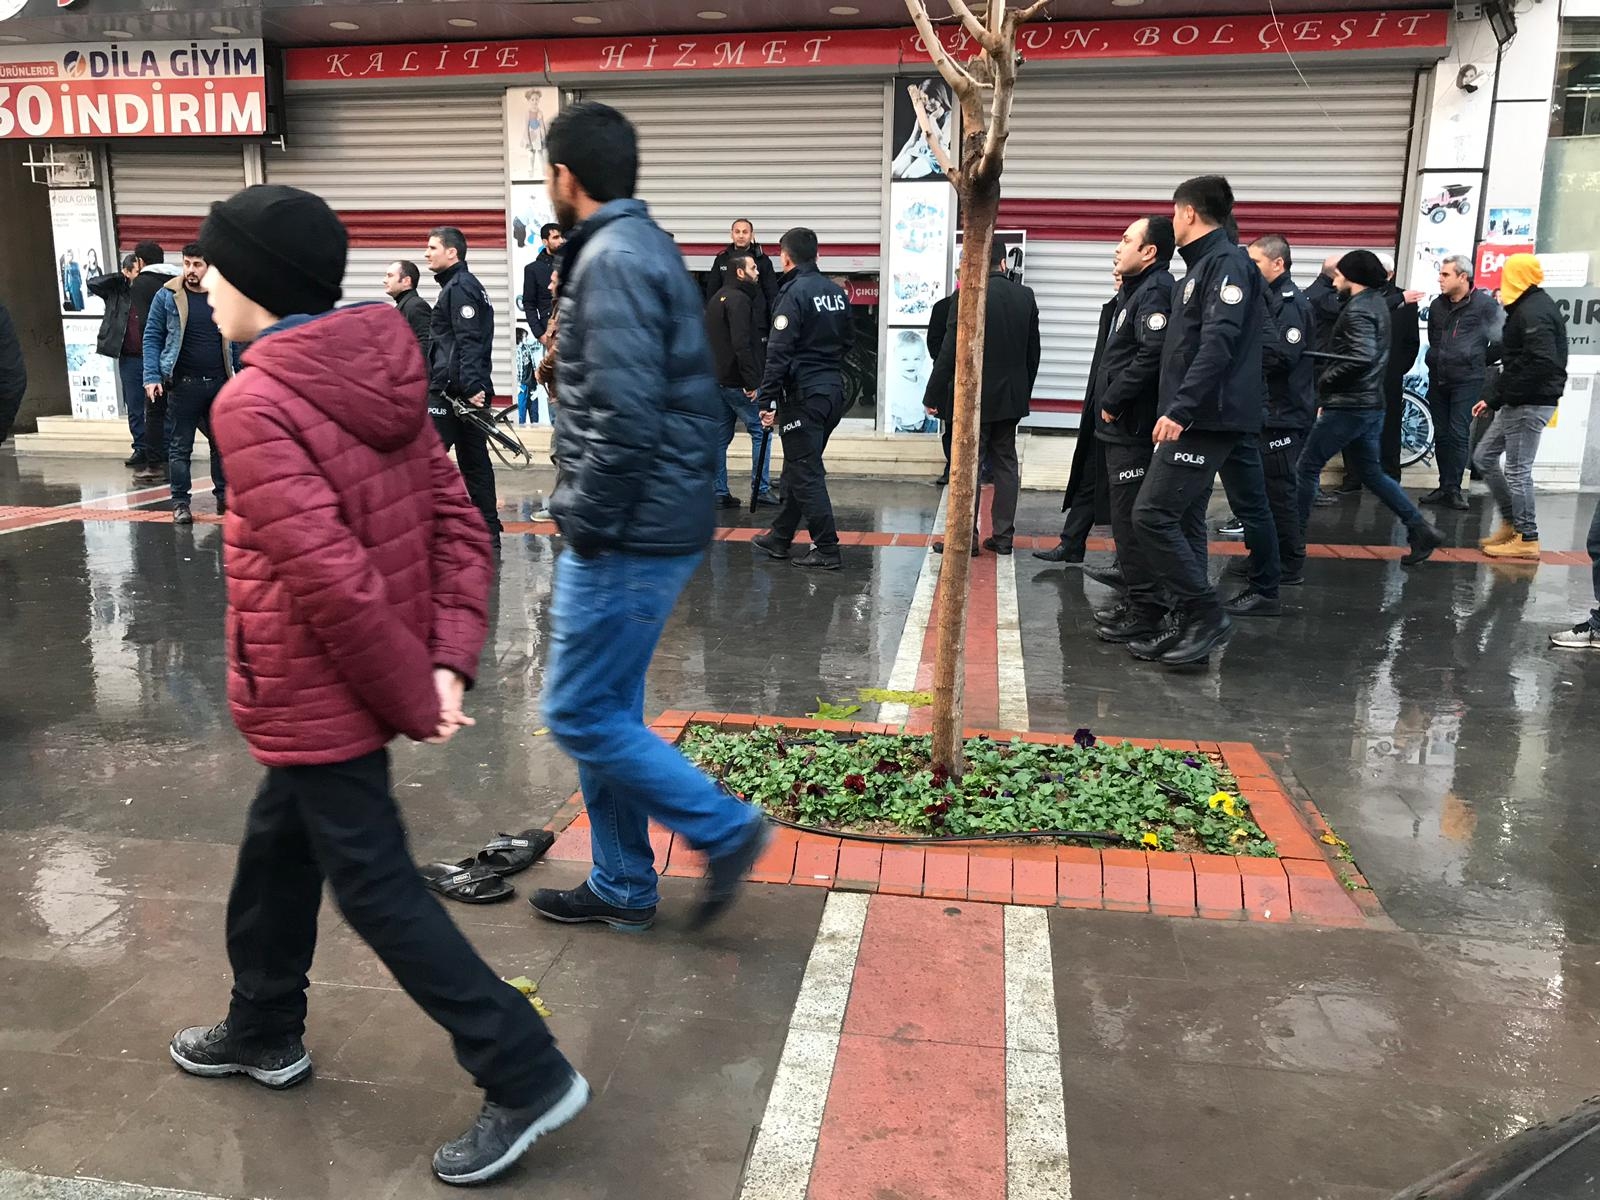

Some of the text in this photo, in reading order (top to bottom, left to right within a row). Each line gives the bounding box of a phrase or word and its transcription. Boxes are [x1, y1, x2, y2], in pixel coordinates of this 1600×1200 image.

[909, 12, 1431, 53] UYUN, BOL ÇEŞİT
[89, 42, 258, 77] DİLA GİYİM
[326, 44, 520, 77] KALİTE
[599, 35, 832, 70] HİZMET
[0, 65, 56, 78] ÜRÜNLERDE
[60, 80, 264, 135] İNDİRİM
